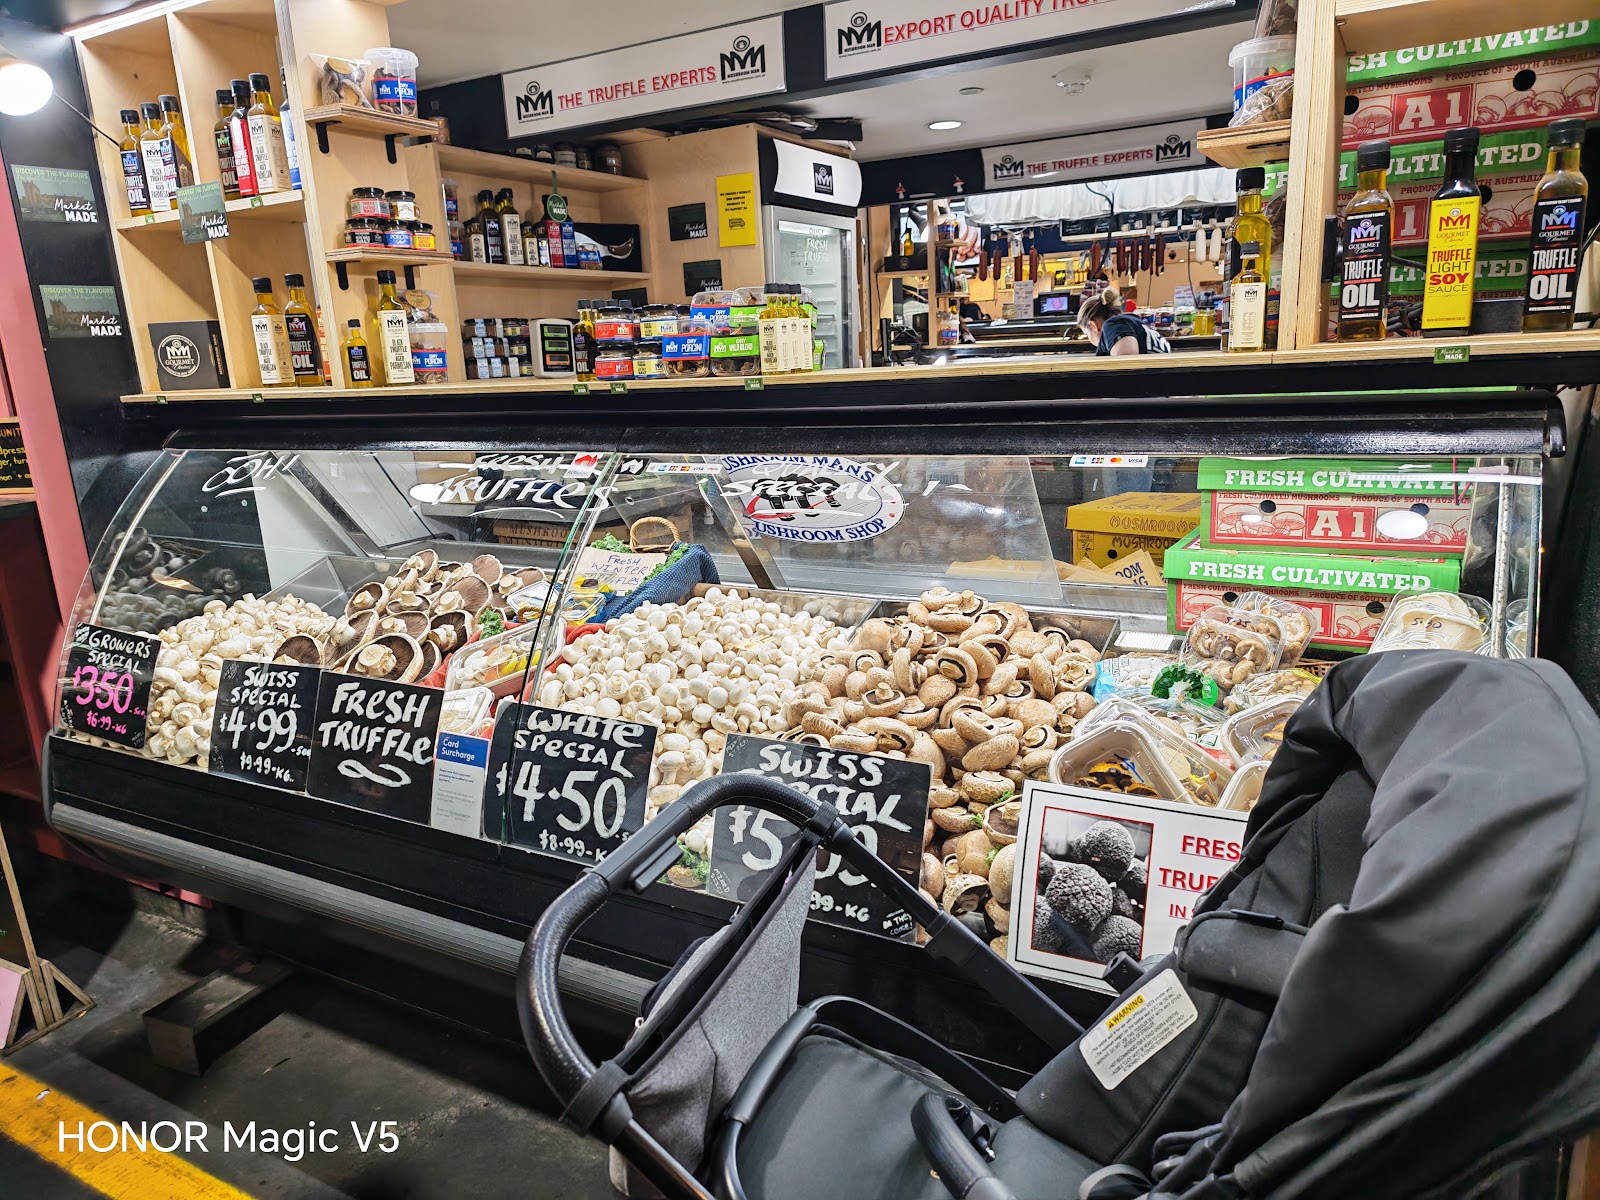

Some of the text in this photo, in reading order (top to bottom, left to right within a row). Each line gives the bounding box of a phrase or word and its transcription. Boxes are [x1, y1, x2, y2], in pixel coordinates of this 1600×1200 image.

[884, 0, 1041, 44] EXPORT QUALITY
[1396, 20, 1590, 65] CULTIVATED
[1377, 76, 1433, 91] MUSHROOMS
[1445, 70, 1490, 82] PRODUCE
[1492, 66, 1505, 74] OF
[1506, 61, 1540, 73] SOUTH
[557, 66, 716, 110] THE TRUFFLE EXPERTS
[1027, 150, 1153, 174] THE TRUFFLE EXPERTS
[15, 166, 45, 176] DISCOVER
[46, 169, 58, 177] THE
[59, 170, 89, 179] FLAVOURS
[54, 198, 93, 211] Market
[65, 210, 98, 223] MADE
[200, 214, 225, 229] Market
[207, 225, 229, 239] MADE
[690, 229, 708, 238] MADE
[1539, 229, 1575, 238] GOURMET
[1348, 241, 1380, 250] GOURMET
[1432, 248, 1472, 263] TRUFFLE
[1533, 247, 1578, 270] TRUFFLE
[1343, 258, 1383, 281] TRUFFLE
[1430, 260, 1471, 274] LIGHT
[1429, 272, 1469, 285] SOY
[1530, 273, 1573, 300] OIL
[1342, 284, 1380, 309] OIL
[1428, 284, 1469, 294] SAUCE
[80, 315, 118, 327] Market
[90, 325, 122, 337] MADE
[290, 340, 312, 352] TRUFFLE
[681, 343, 703, 353] PORCINI
[291, 354, 315, 369] OIL
[577, 361, 589, 372] OIL
[353, 370, 368, 380] OIL
[1225, 470, 1305, 487] FRESH
[1218, 492, 1243, 500] FRESH
[1244, 492, 1290, 500] CULTIVATED
[1291, 493, 1340, 501] MUSHROOMS
[1351, 495, 1388, 503] PRODUCE
[1404, 496, 1433, 504] SOUTH
[509, 523, 568, 541] MUSHROO
[845, 518, 886, 539] SHOP
[1110, 515, 1201, 535] MUSHROOMS
[607, 554, 641, 566] FRESH
[591, 562, 649, 576] WINTER
[1189, 560, 1431, 591] FRESH CULTIVATED
[1183, 583, 1207, 591] FRESH
[1208, 584, 1251, 593] CULTIVATED
[1310, 591, 1343, 599] PRODUCE
[1359, 594, 1388, 603] SOUTH
[243, 666, 300, 689] SWISS
[332, 682, 431, 728] FRESH
[527, 709, 645, 748] WHITE
[318, 720, 434, 765] TRUFFLE
[442, 738, 460, 749] Card
[441, 747, 475, 762] Surcharge
[759, 743, 886, 787] SWISS
[495, 760, 627, 839] $4.50
[1181, 834, 1241, 861] FRES
[1158, 867, 1221, 892] TRUF
[1169, 903, 1187, 919] IN
[1111, 996, 1143, 1023] WARNING
